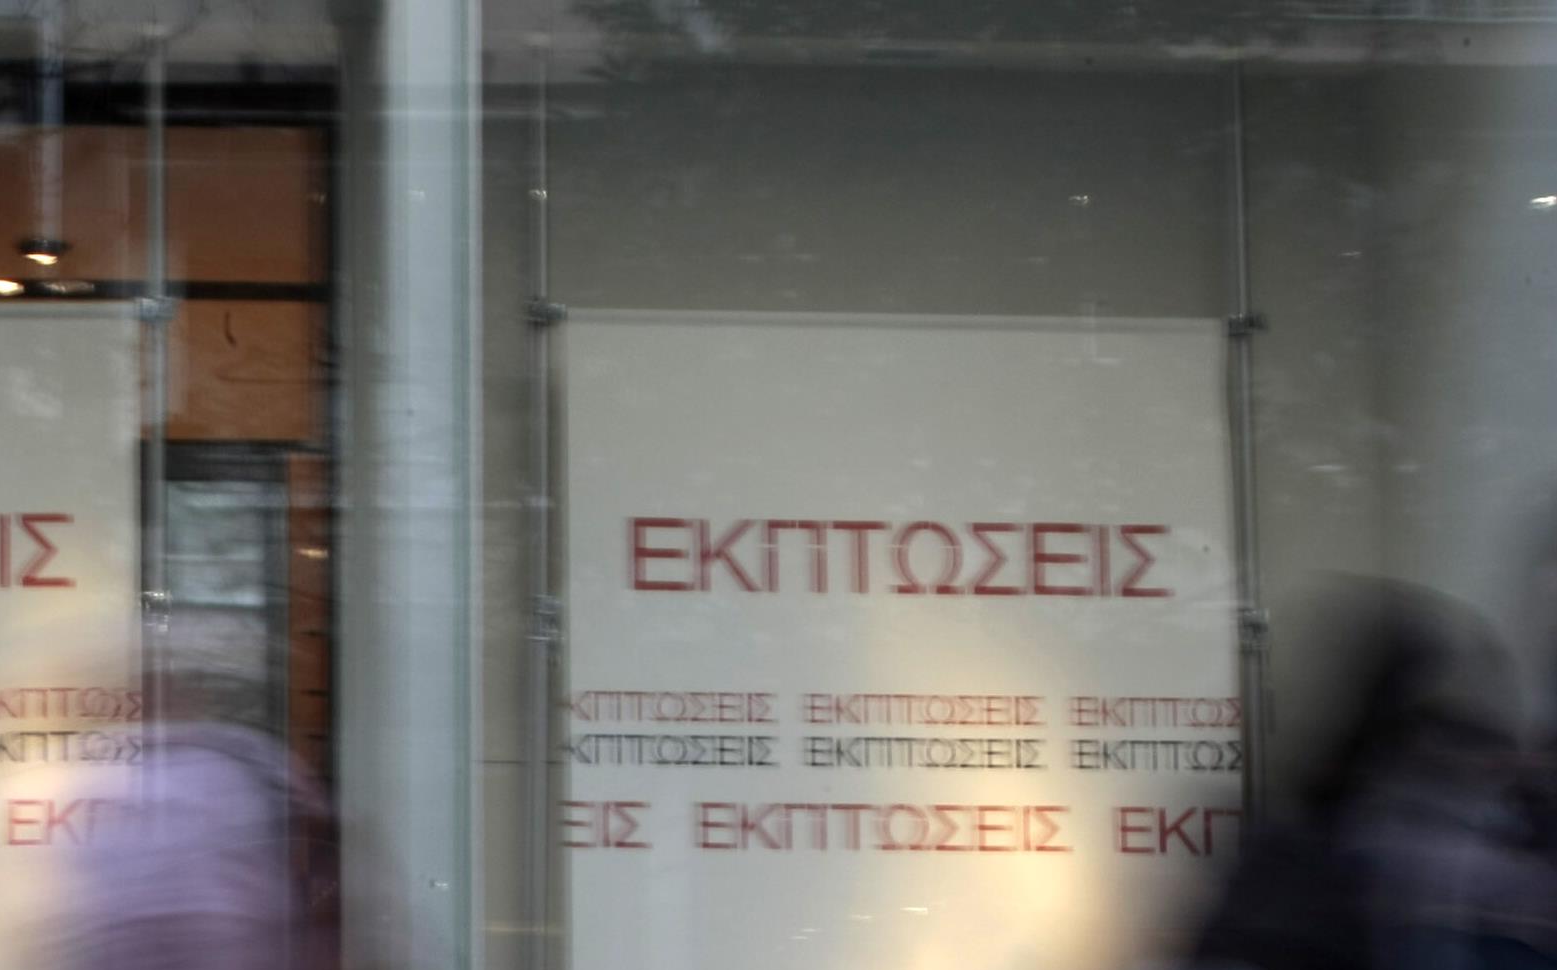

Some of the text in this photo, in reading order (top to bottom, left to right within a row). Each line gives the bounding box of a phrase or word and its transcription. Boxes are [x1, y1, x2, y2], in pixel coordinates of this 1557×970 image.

[631, 517, 1174, 598] ΕΚΠΤΩΣΕΙΣ
[804, 693, 1046, 726] ΕΚΠΤΩΣΕΙΣ
[804, 736, 1047, 769] ΕΚΠΤΩΣΕΙΣ
[696, 802, 1072, 853] ΕΚΠΤΩΣΕΙΣ
